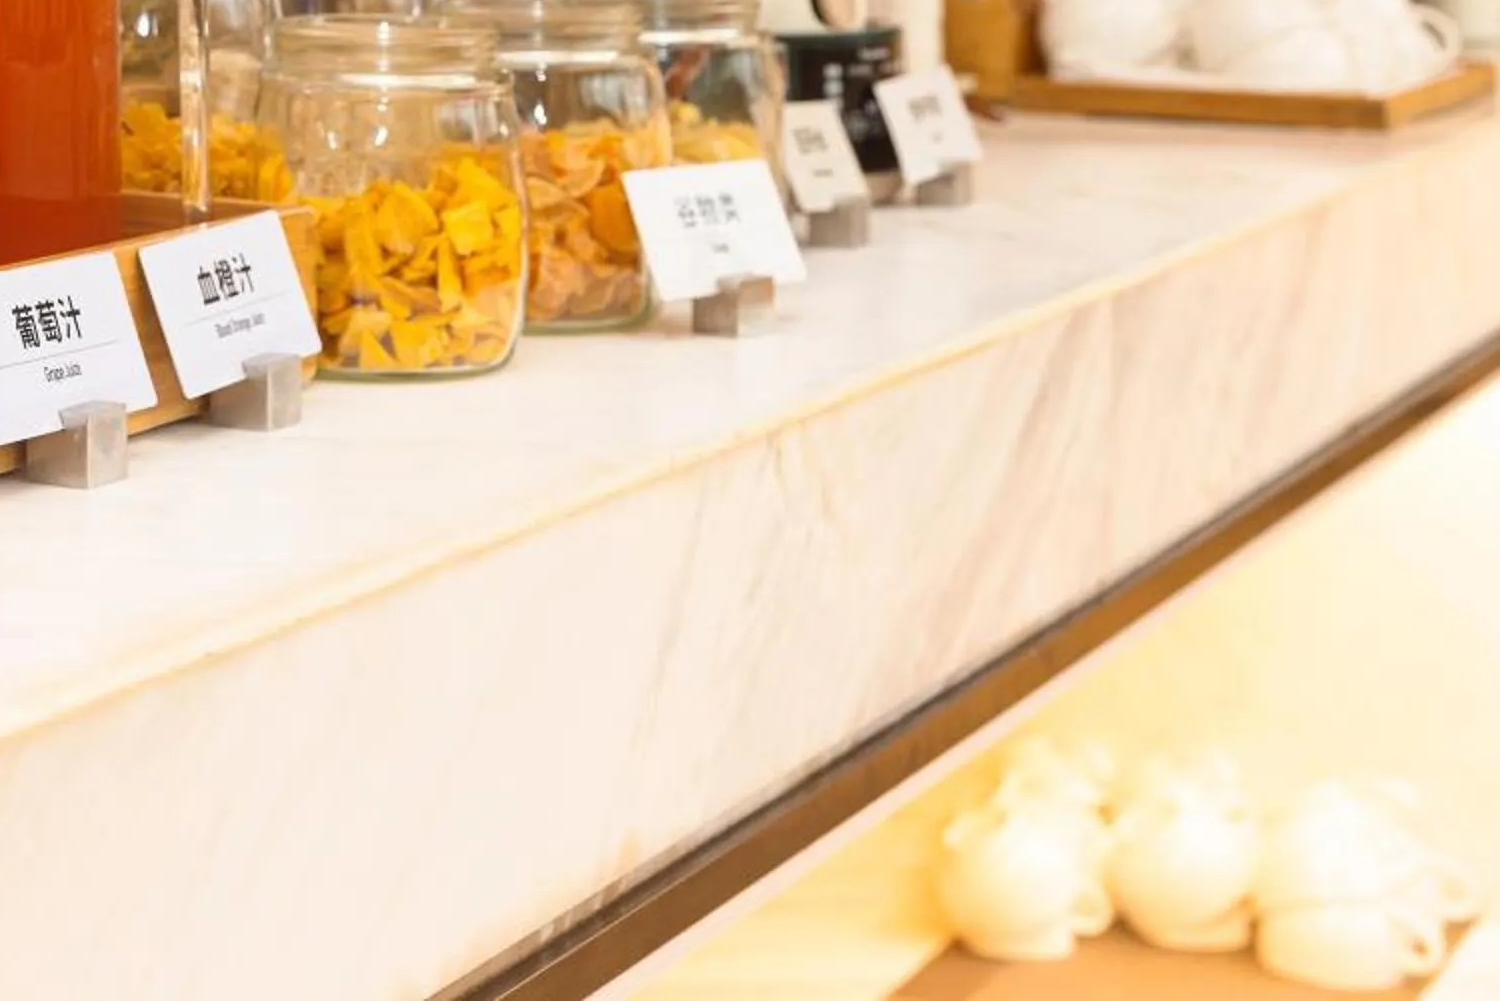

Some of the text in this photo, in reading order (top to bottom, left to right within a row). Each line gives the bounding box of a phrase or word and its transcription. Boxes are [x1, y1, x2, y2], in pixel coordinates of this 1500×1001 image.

[197, 252, 255, 305] 血橙汁
[11, 295, 83, 349] 葡萄汁
[43, 362, 82, 384] Grape Juice
